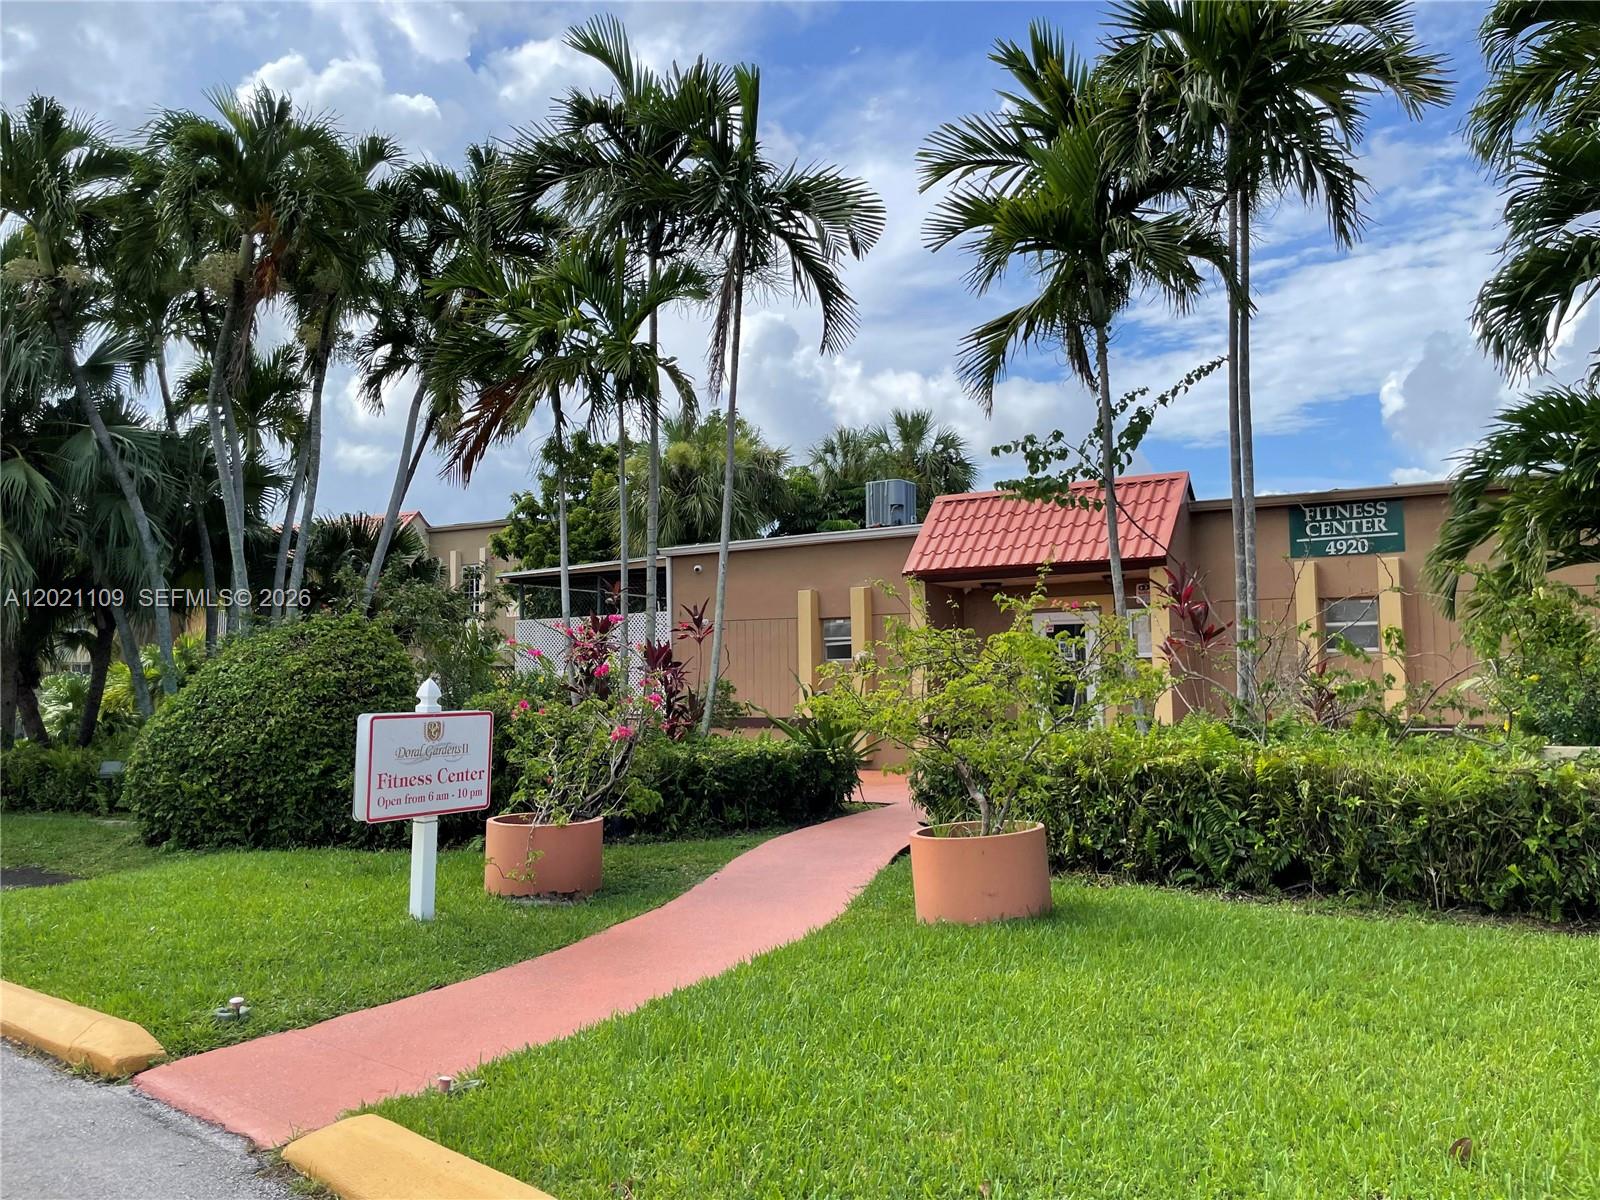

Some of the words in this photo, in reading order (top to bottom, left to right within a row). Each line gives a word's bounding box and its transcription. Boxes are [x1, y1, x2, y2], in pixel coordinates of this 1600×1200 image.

[1304, 501, 1388, 522] FITNESS
[1305, 517, 1388, 537] CENTER
[1325, 538, 1369, 555] 4920
[397, 744, 425, 759] Doral
[425, 742, 461, 761] Gardens
[377, 772, 433, 790] Fitness
[437, 767, 485, 785] Center
[377, 795, 402, 810] Open
[404, 793, 426, 805] from
[428, 791, 434, 802] 6
[436, 792, 449, 801] am
[458, 788, 468, 799] 10
[470, 788, 483, 800] pm
